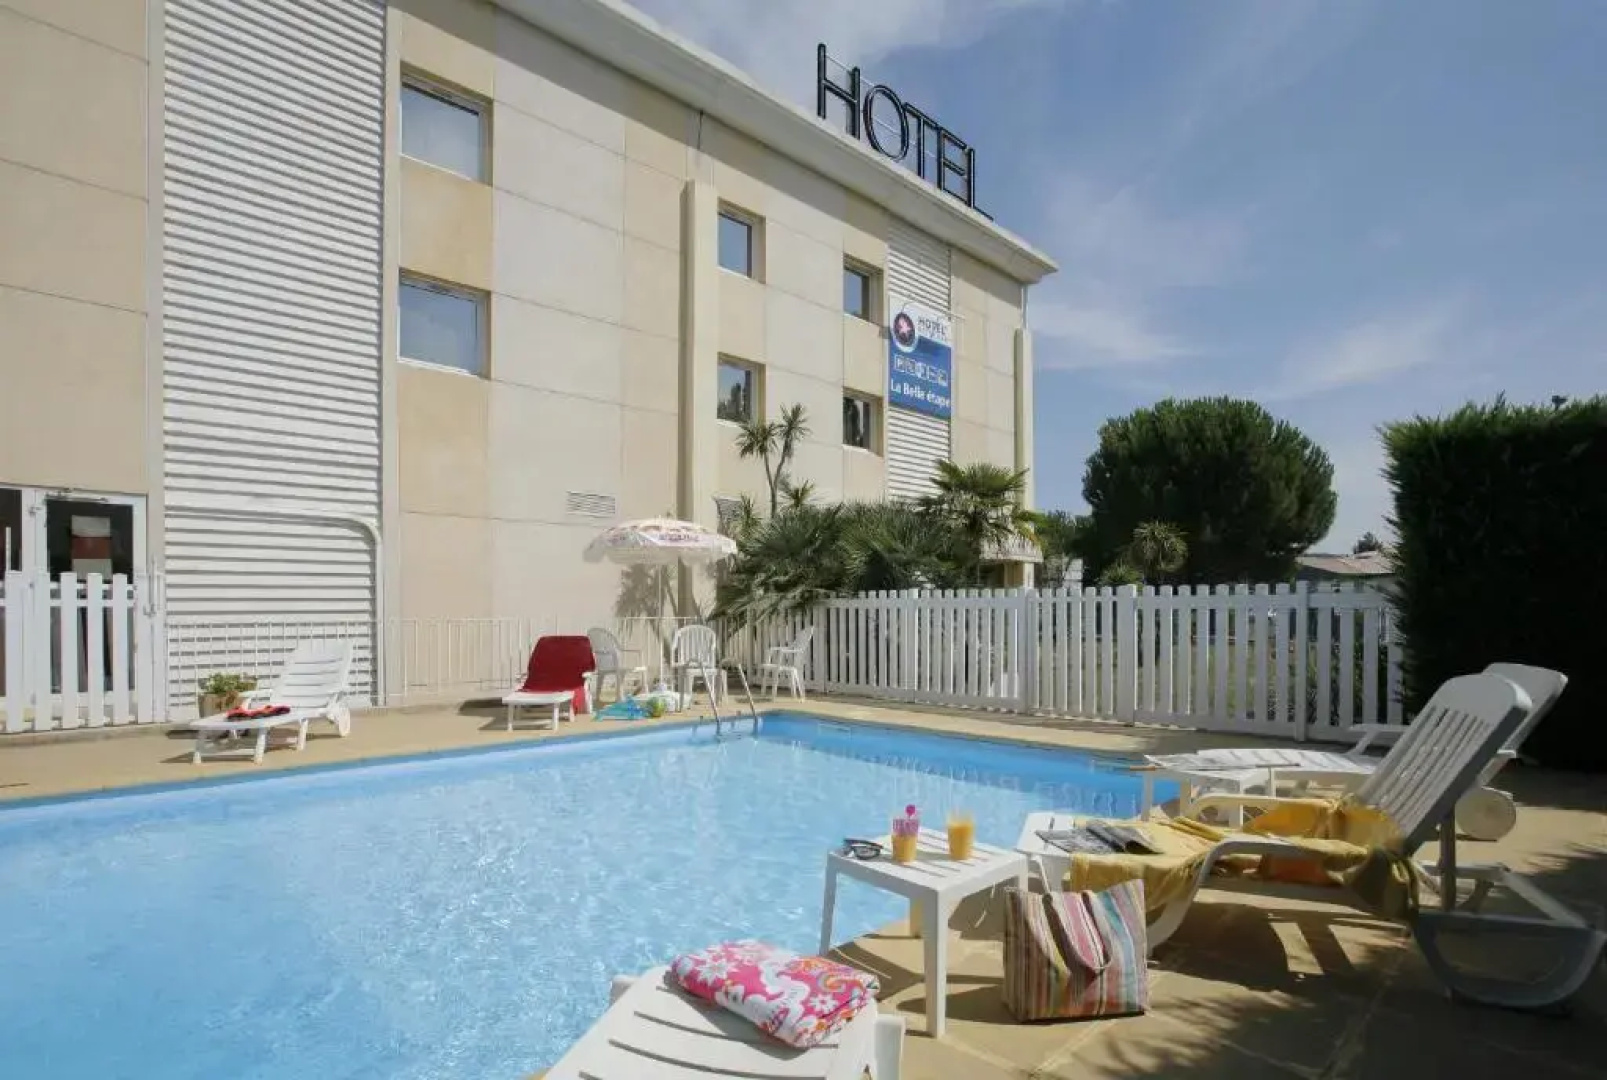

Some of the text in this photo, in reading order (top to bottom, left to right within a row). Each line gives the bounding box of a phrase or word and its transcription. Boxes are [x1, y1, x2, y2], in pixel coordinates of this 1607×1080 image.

[817, 43, 994, 221] HOTEL
[891, 378, 902, 393] La
[903, 382, 925, 399] Belle
